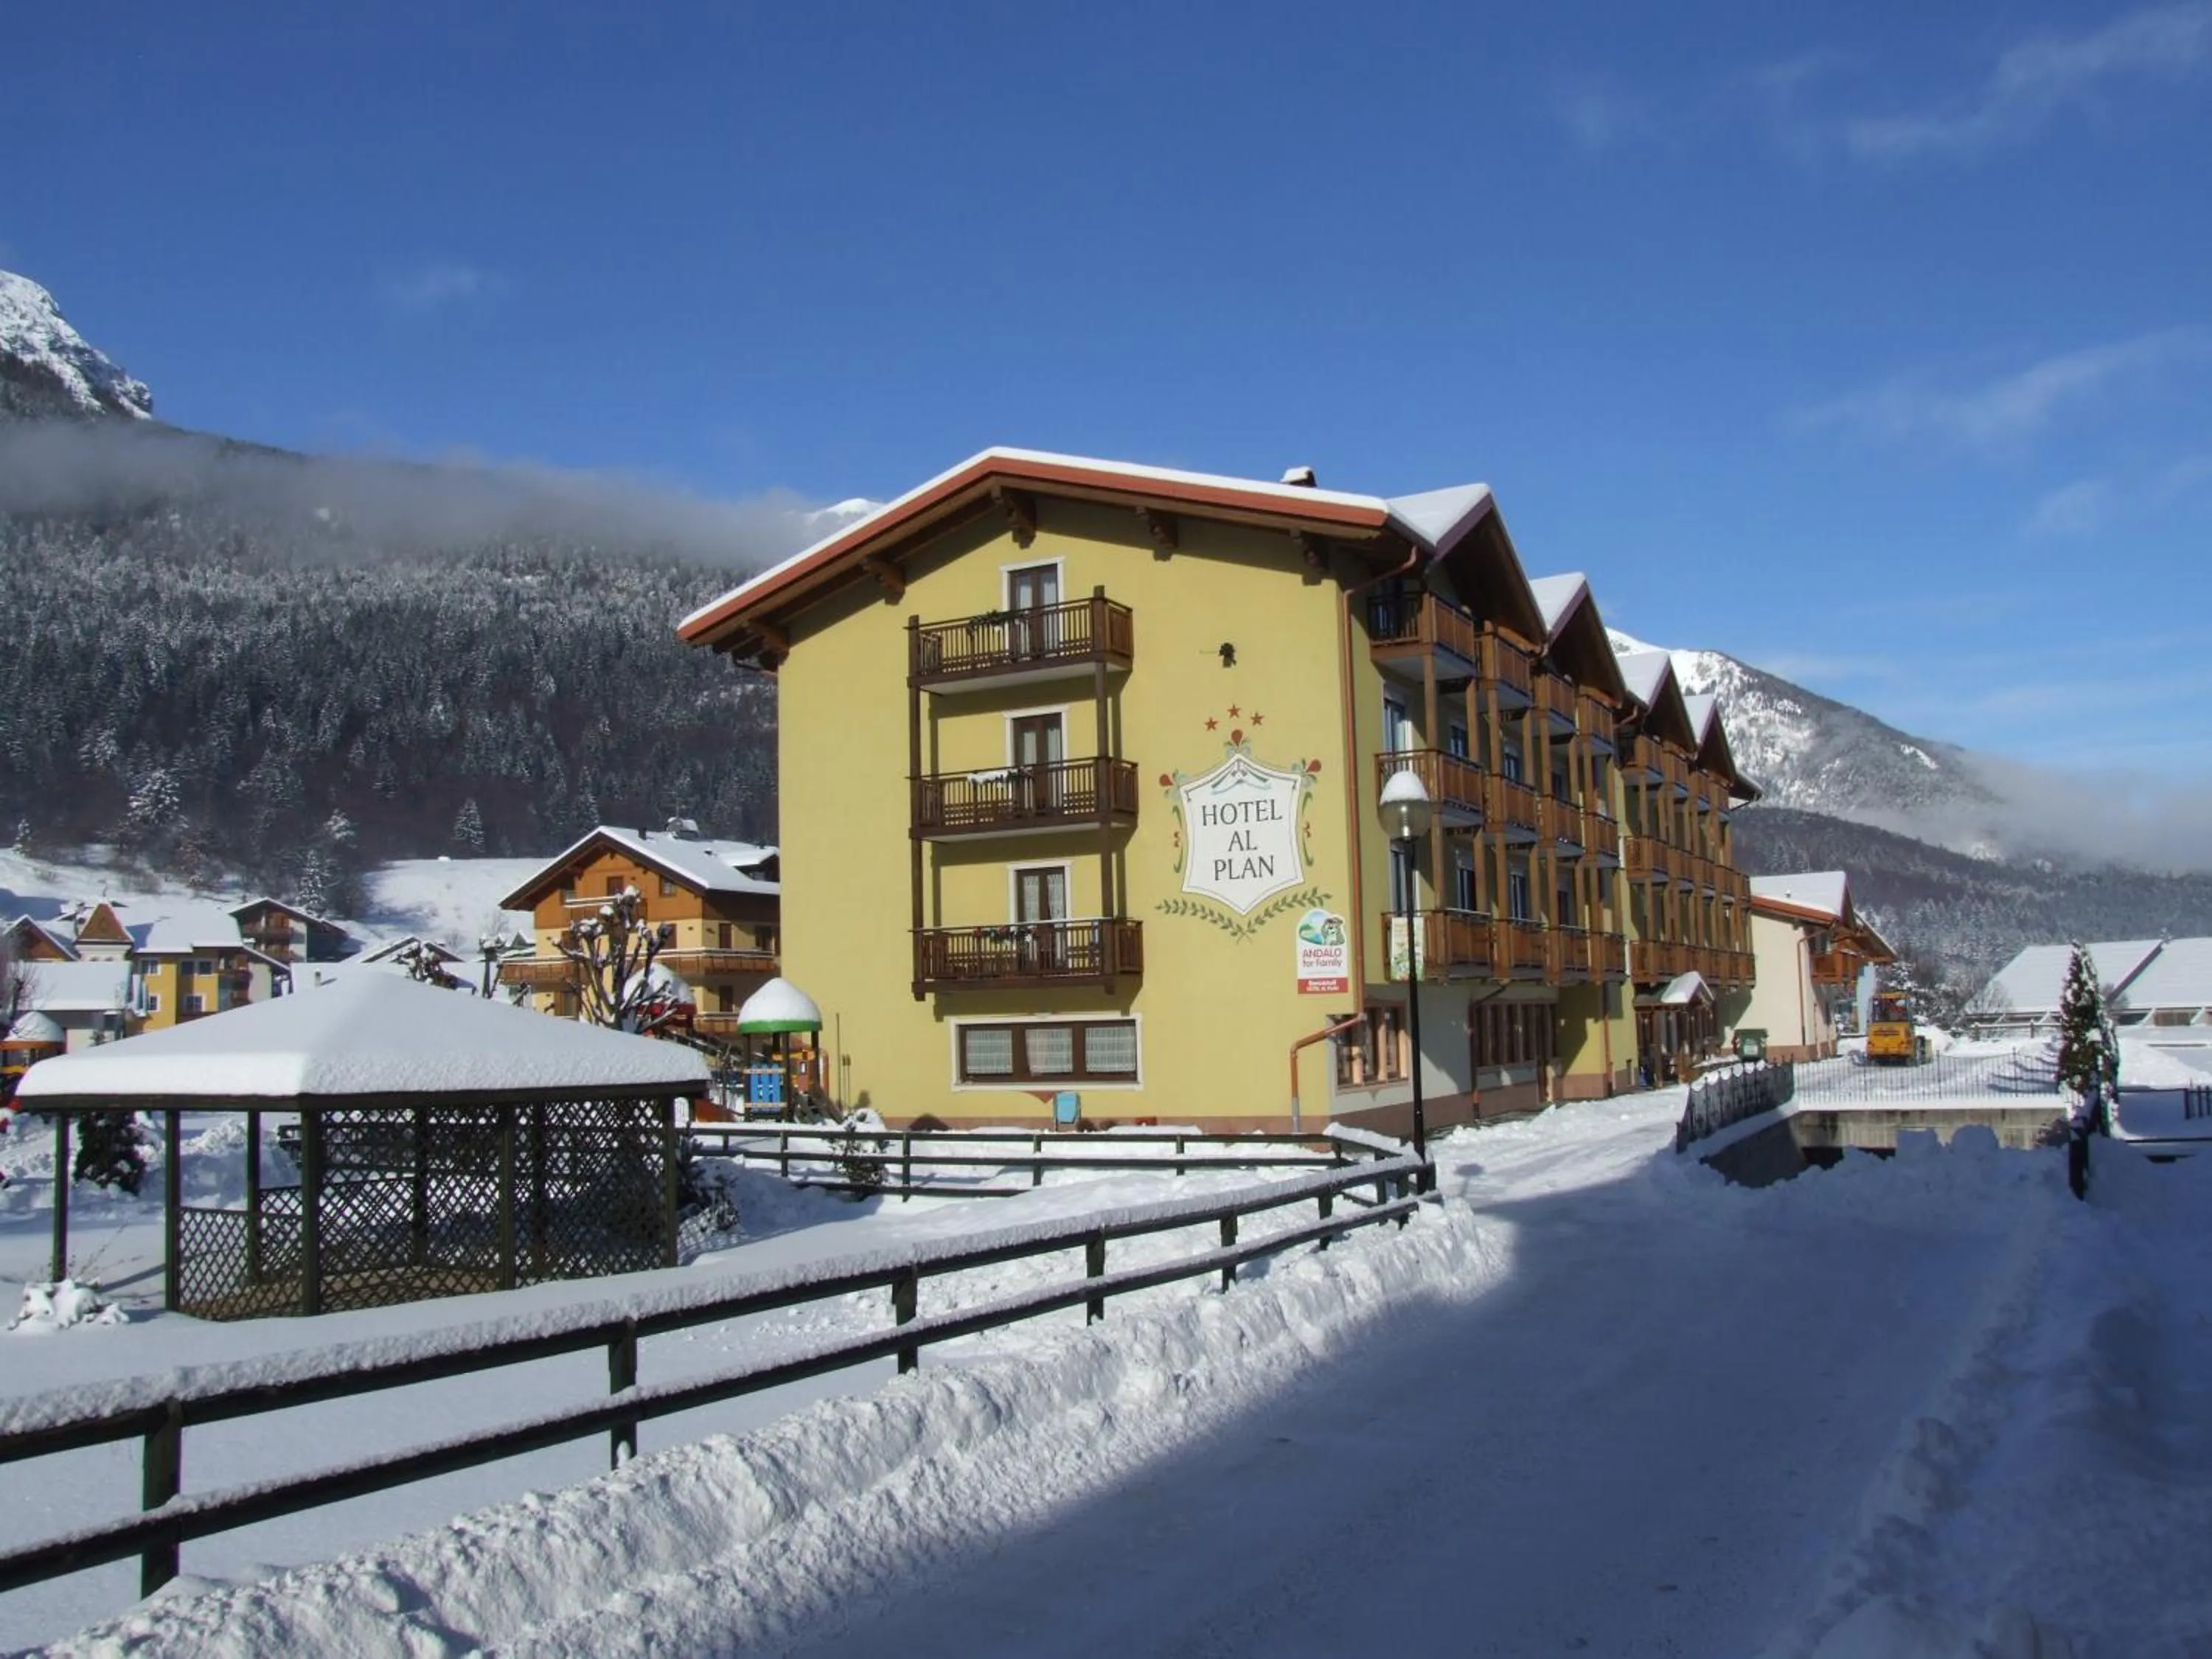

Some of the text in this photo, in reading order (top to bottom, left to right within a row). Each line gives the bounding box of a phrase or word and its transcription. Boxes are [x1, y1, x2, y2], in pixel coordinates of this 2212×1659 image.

[1202, 799, 1283, 826] HOTEL
[1228, 830, 1258, 852] AL
[1214, 855, 1274, 881] PLAN
[1303, 948, 1342, 958] ANDALO
[1303, 960, 1313, 968] for
